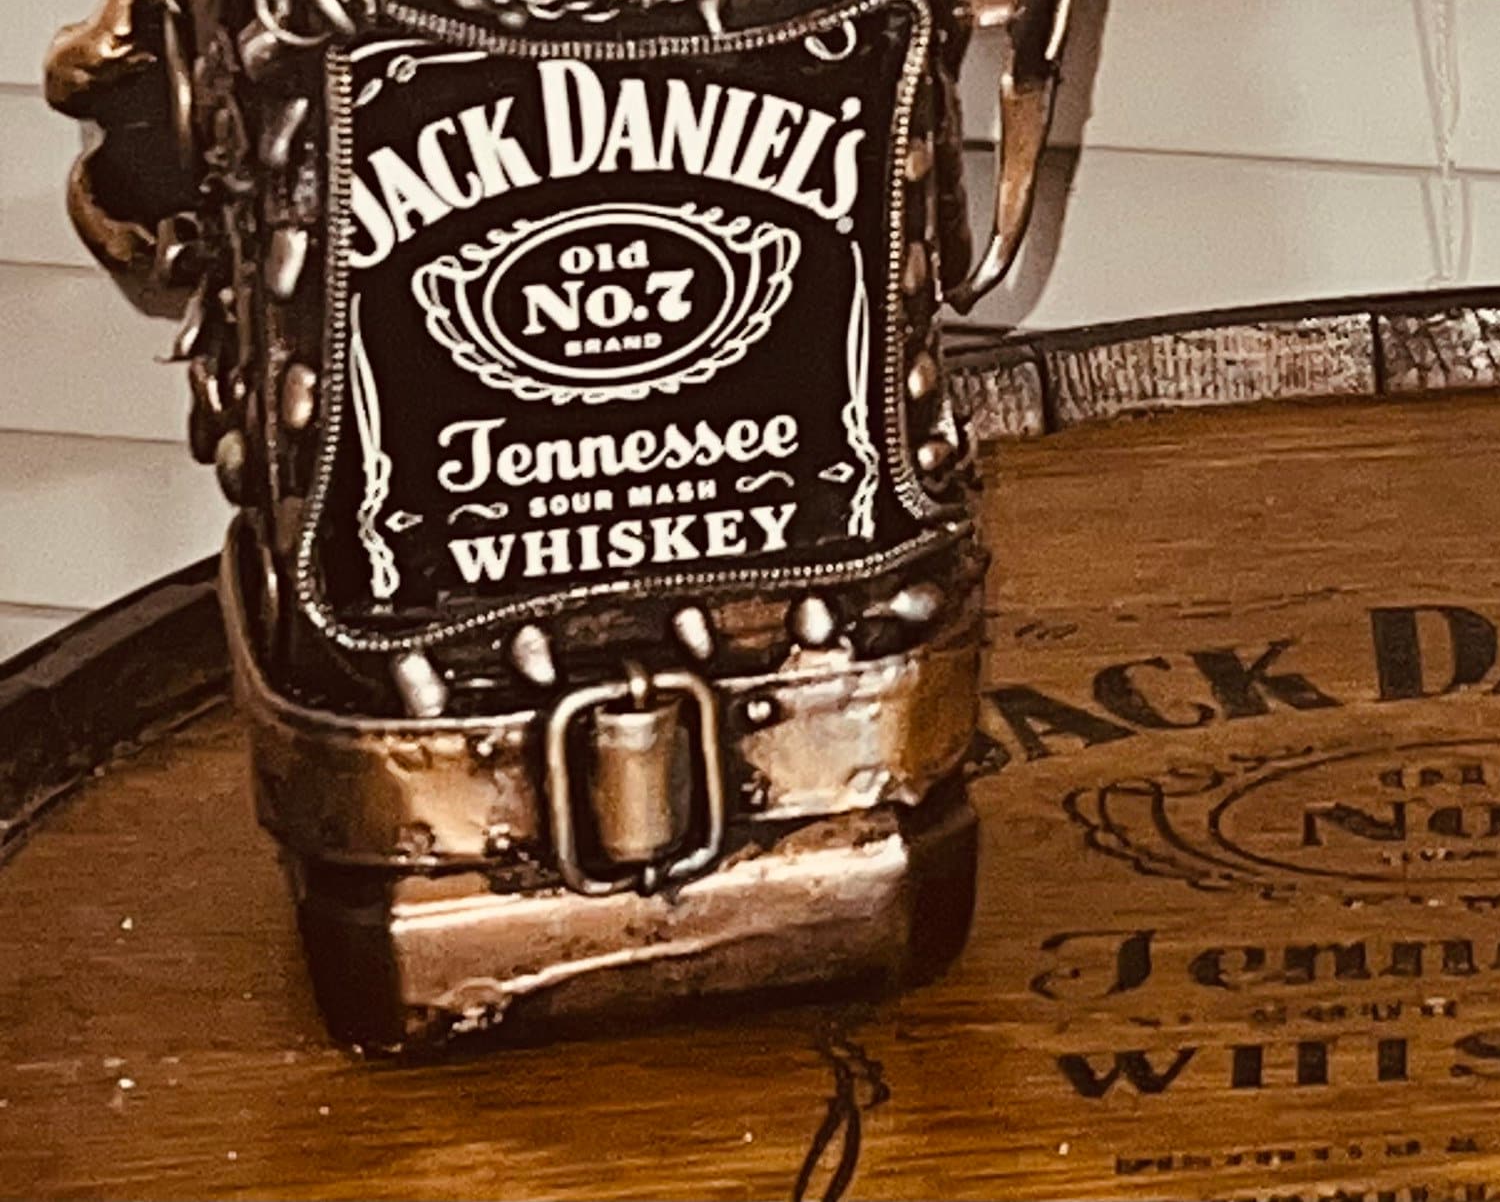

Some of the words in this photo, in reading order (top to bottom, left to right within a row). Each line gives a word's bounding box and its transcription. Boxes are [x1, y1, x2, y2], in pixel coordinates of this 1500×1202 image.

[349, 97, 541, 270] JACK
[537, 59, 867, 221] DANIEL'S
[558, 240, 650, 275] Old
[564, 333, 662, 358] BRAND
[436, 414, 800, 493] Tennessee
[528, 488, 614, 519] SOUR
[627, 479, 718, 509] MASH
[447, 502, 799, 584] WHISKEY
